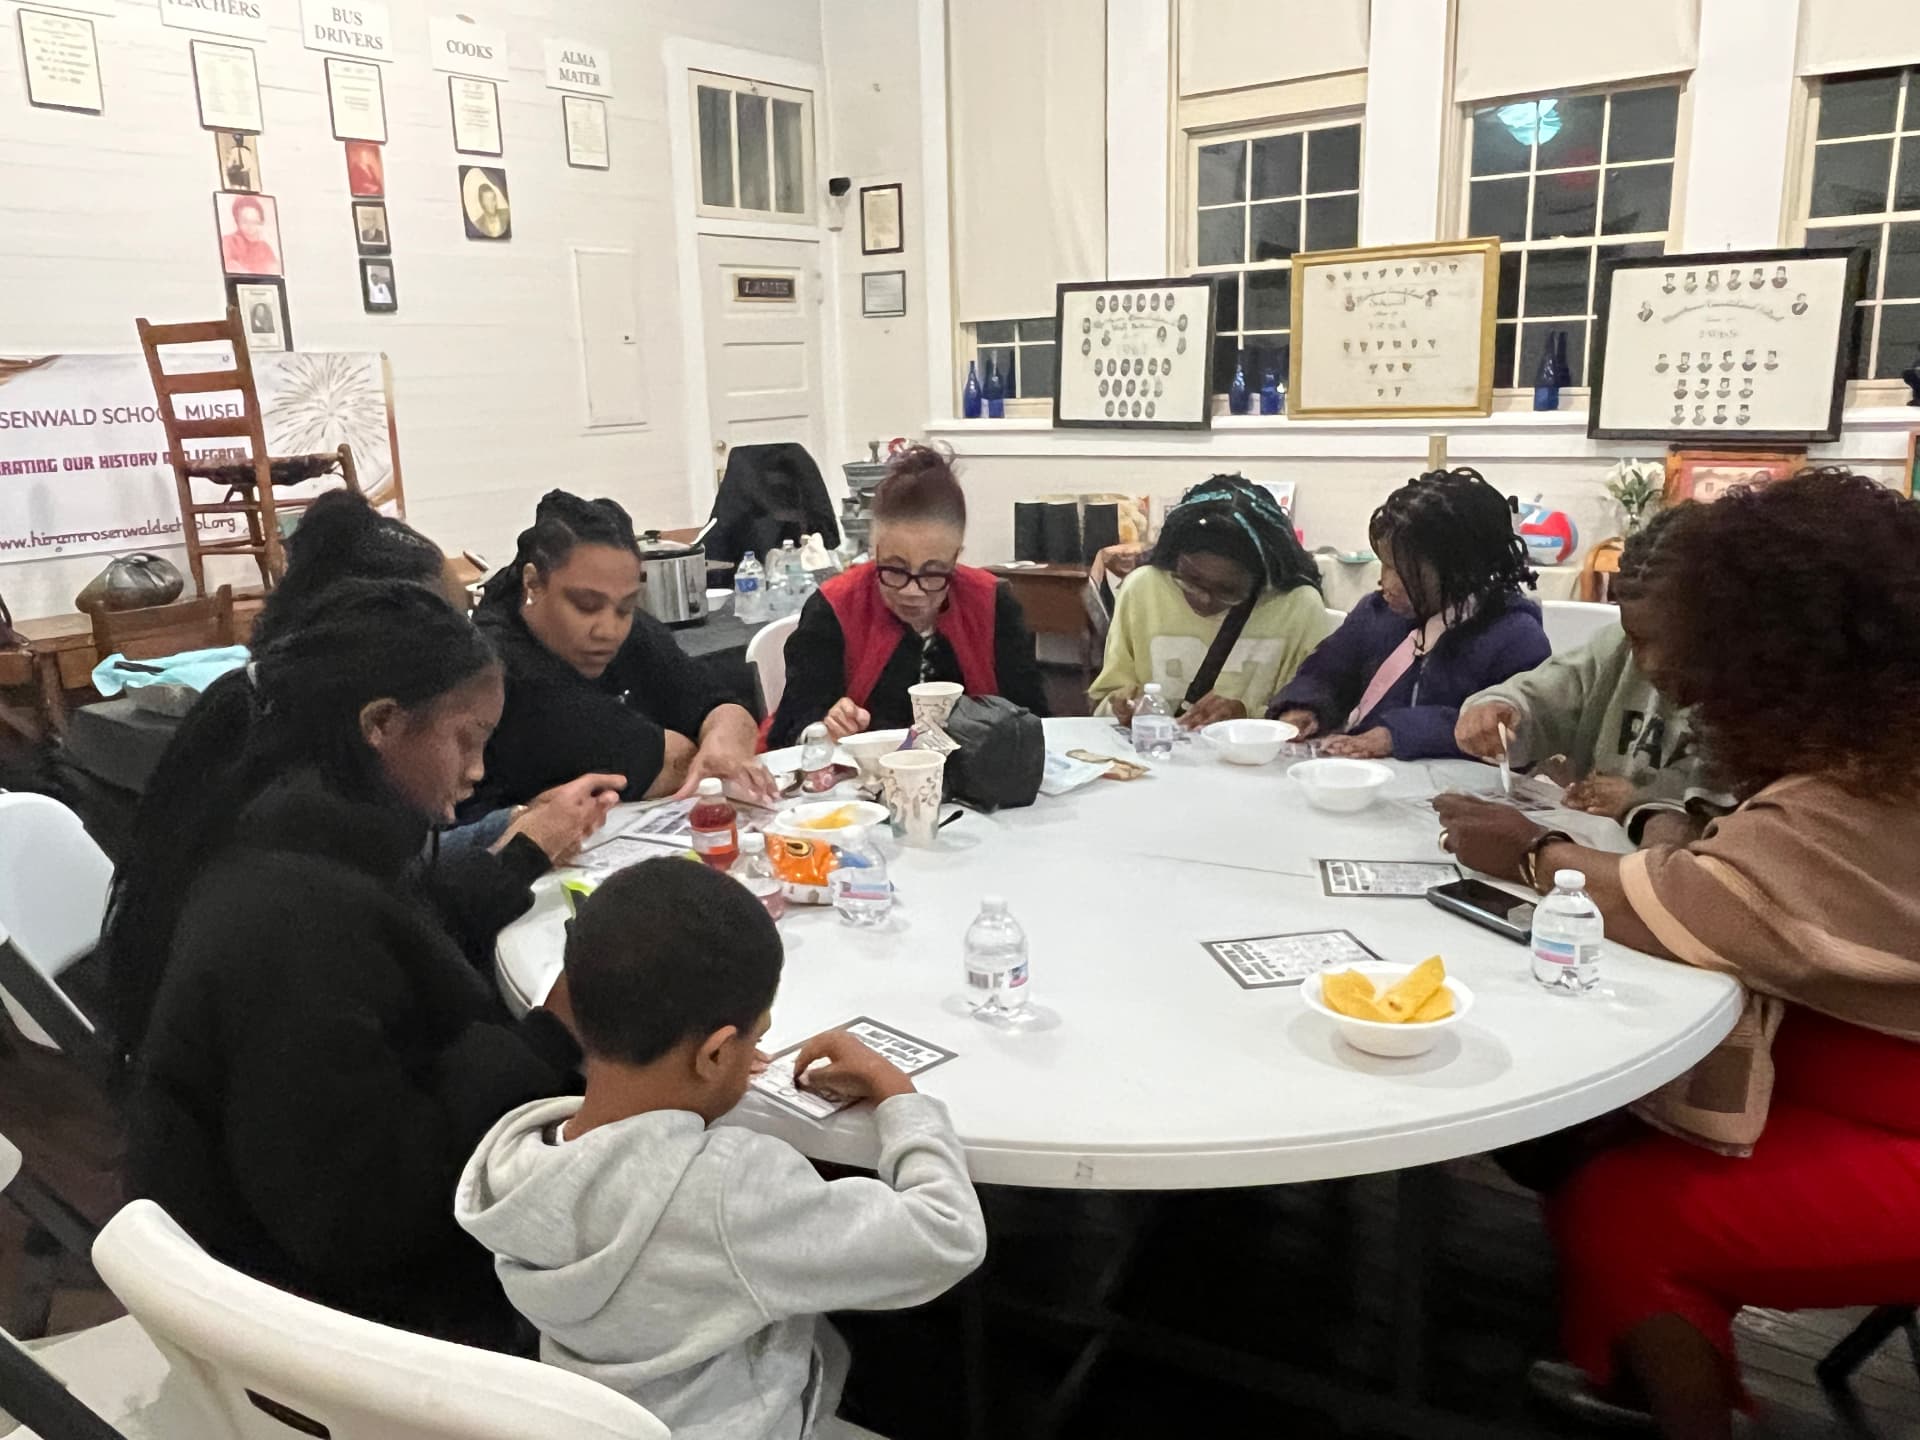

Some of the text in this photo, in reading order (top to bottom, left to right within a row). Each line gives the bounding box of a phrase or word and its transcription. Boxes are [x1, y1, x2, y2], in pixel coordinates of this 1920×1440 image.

[167, 0, 261, 19] ACHERS
[332, 7, 363, 26] BUS
[314, 24, 384, 50] DRIVERS
[446, 39, 493, 59] COOKS
[561, 50, 596, 68] ALMA
[559, 67, 601, 86] MATER
[102, 406, 163, 424] SCHO
[185, 403, 239, 420] MUSE
[63, 456, 95, 471] OUR
[99, 452, 157, 469] HISTORY
